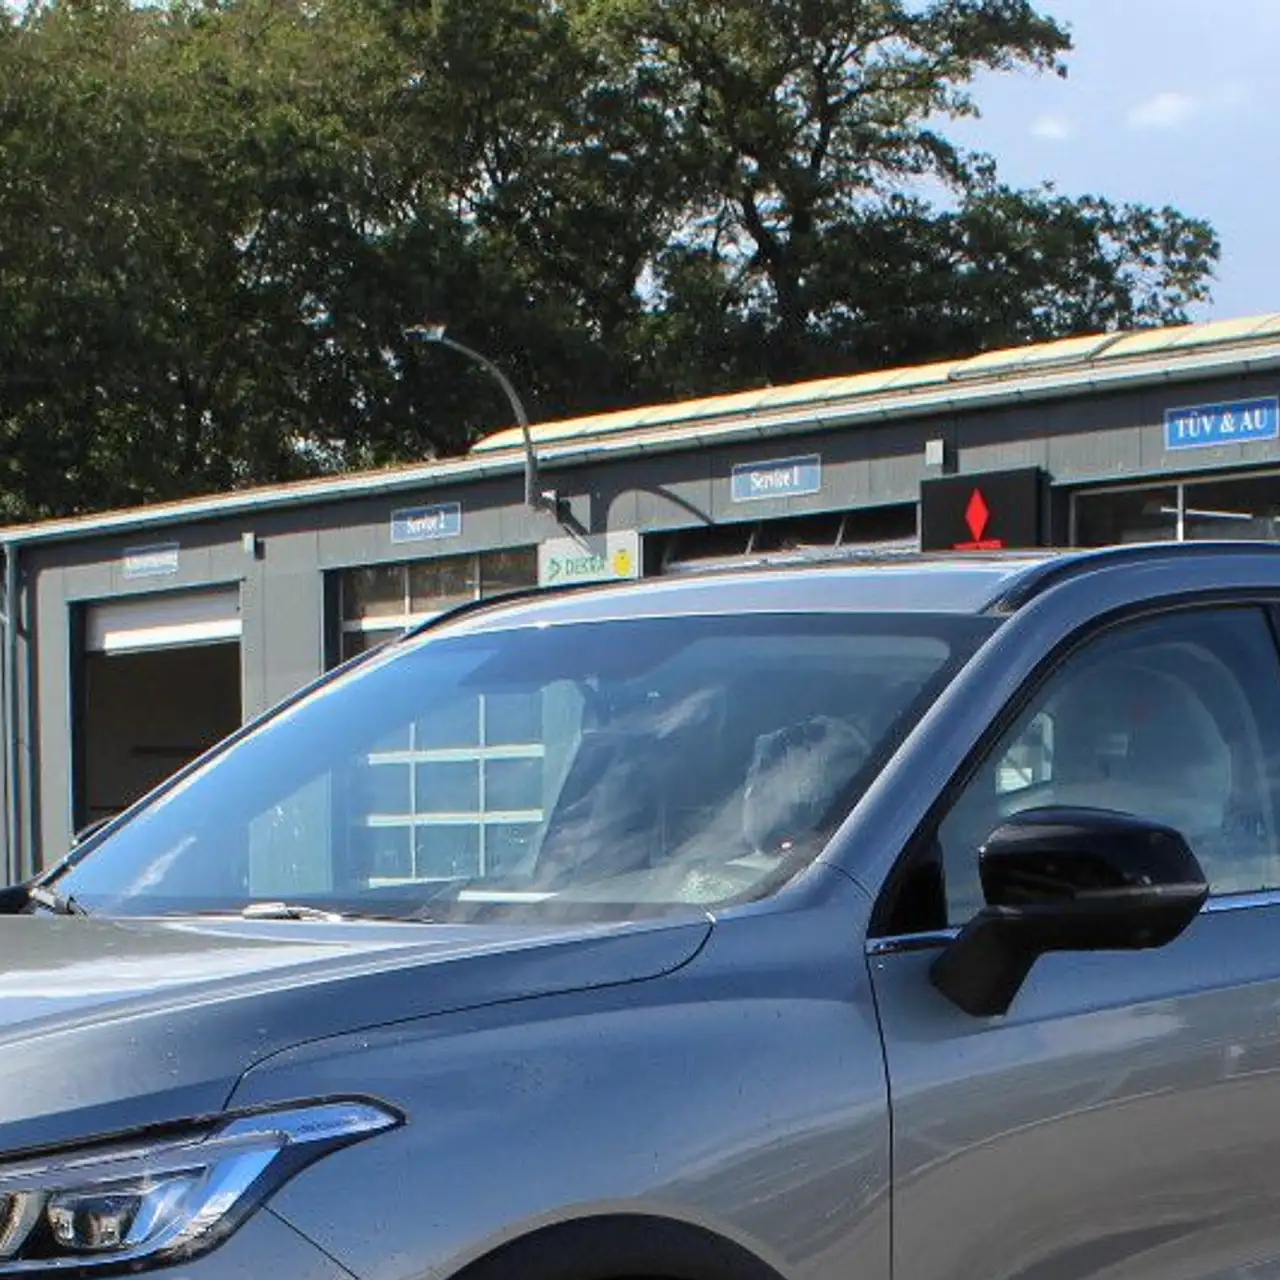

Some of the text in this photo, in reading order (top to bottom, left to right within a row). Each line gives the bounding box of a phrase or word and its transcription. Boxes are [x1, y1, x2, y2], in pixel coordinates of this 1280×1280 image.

[1177, 408, 1267, 438] TÜV & AU
[566, 555, 605, 576] DEKRA
